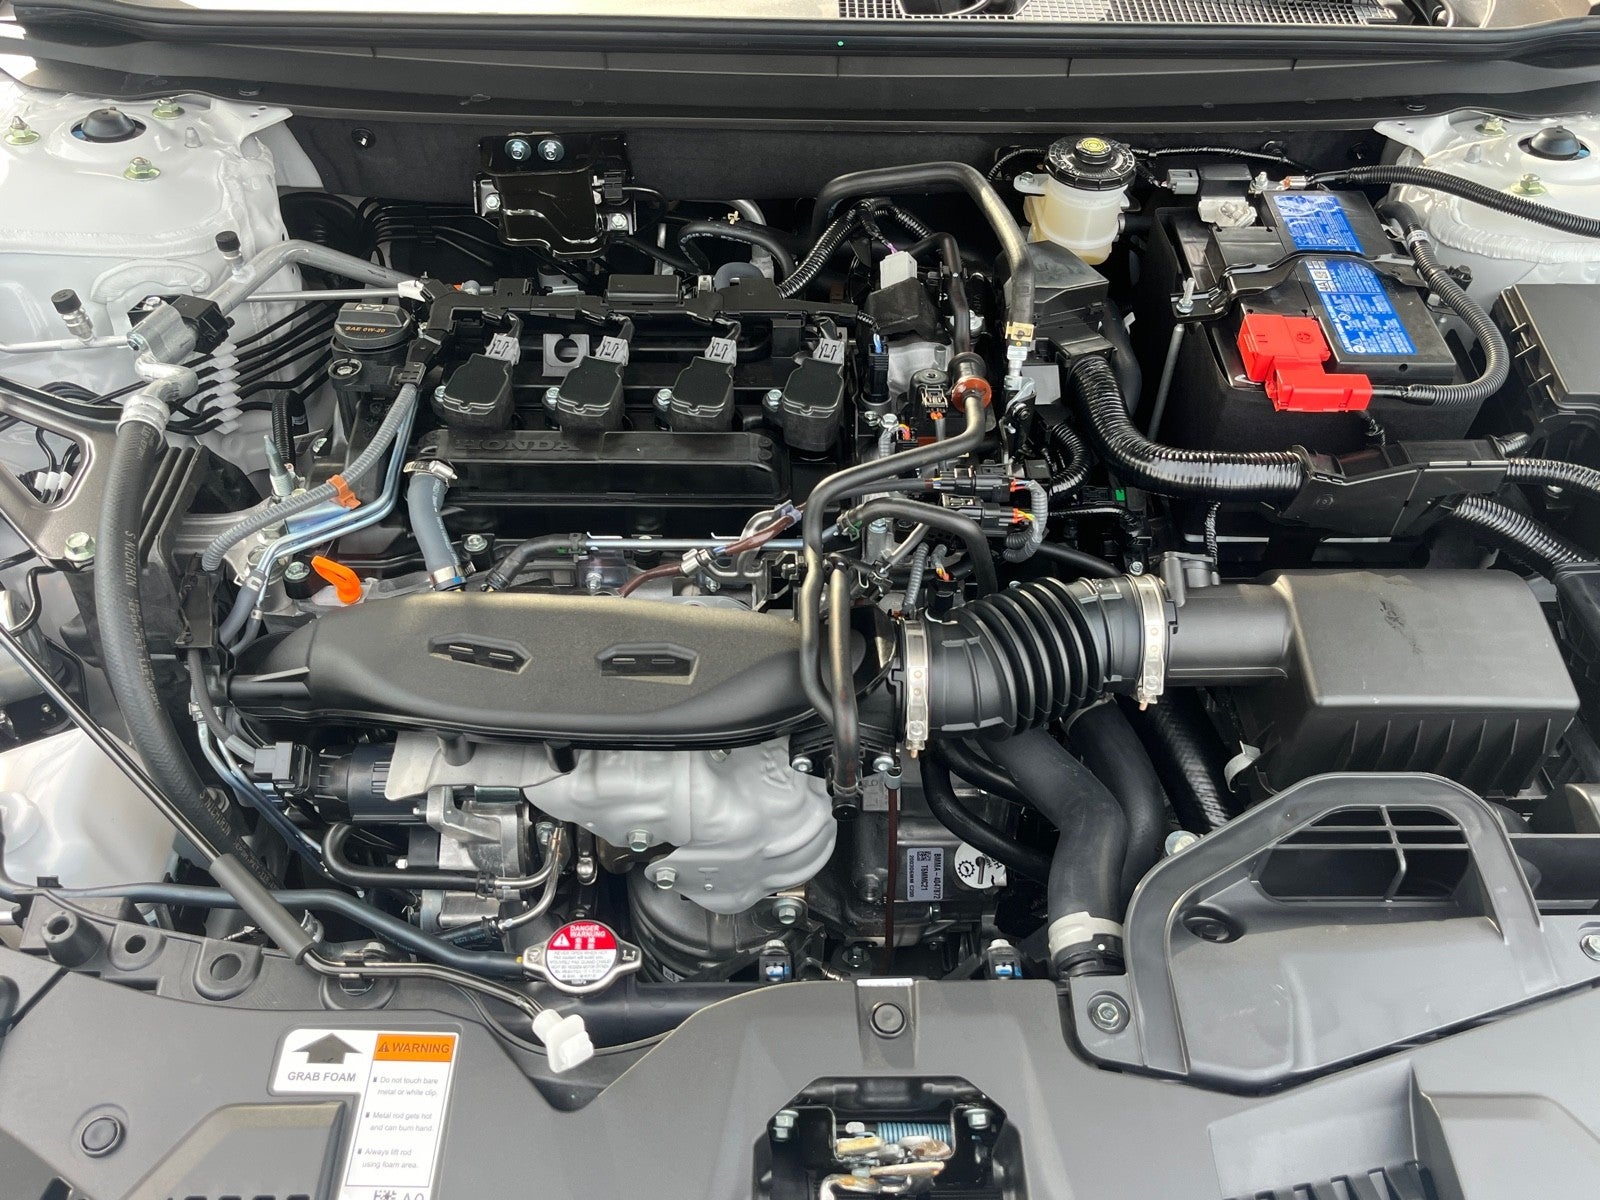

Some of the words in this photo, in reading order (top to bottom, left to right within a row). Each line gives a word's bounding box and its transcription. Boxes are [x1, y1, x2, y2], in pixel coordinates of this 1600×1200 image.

[455, 439, 580, 452] HONDA
[392, 1042, 450, 1054] WARNING
[287, 1071, 321, 1081] GRAB
[322, 1072, 356, 1082] FOAM
[372, 1111, 392, 1119] Metal
[364, 1148, 389, 1156] Always
[362, 1161, 381, 1169] using
